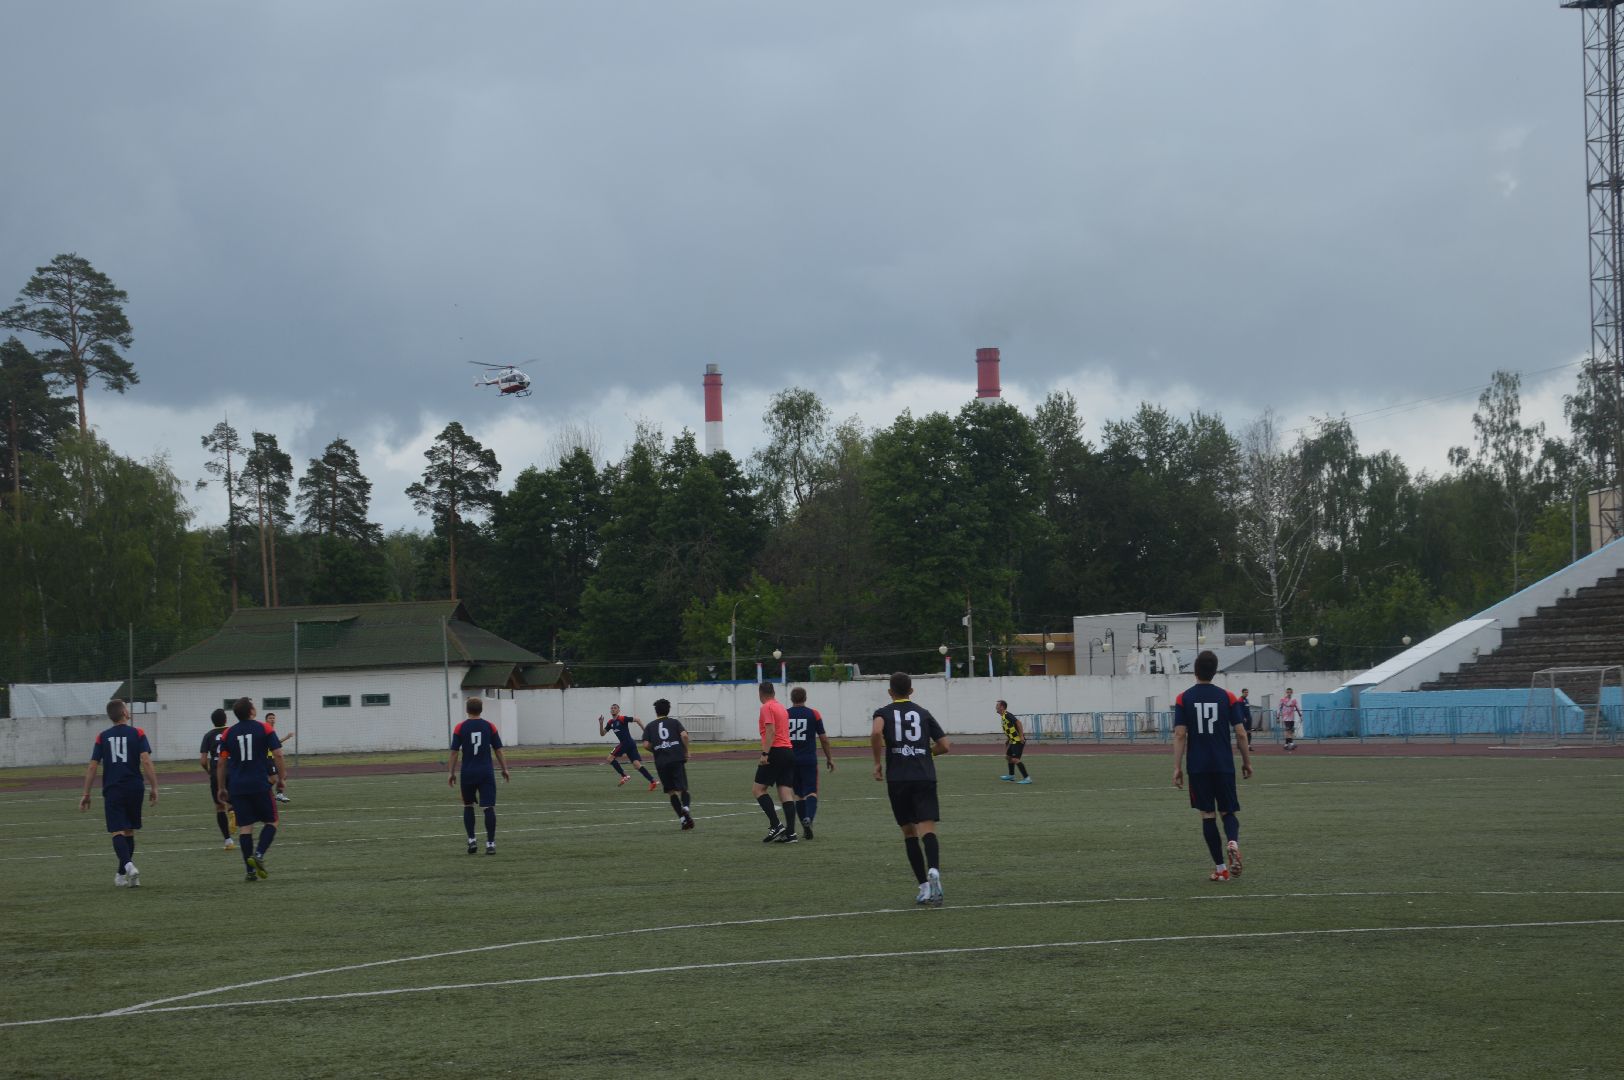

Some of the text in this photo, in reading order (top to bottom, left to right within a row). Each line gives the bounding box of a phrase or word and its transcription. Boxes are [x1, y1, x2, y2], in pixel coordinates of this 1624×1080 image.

[658, 721, 669, 740] 6
[788, 718, 808, 741] 22
[893, 709, 922, 741] 13
[1194, 703, 1218, 734] 17
[108, 736, 128, 763] 14
[237, 733, 253, 762] 11
[471, 732, 482, 756] 7
